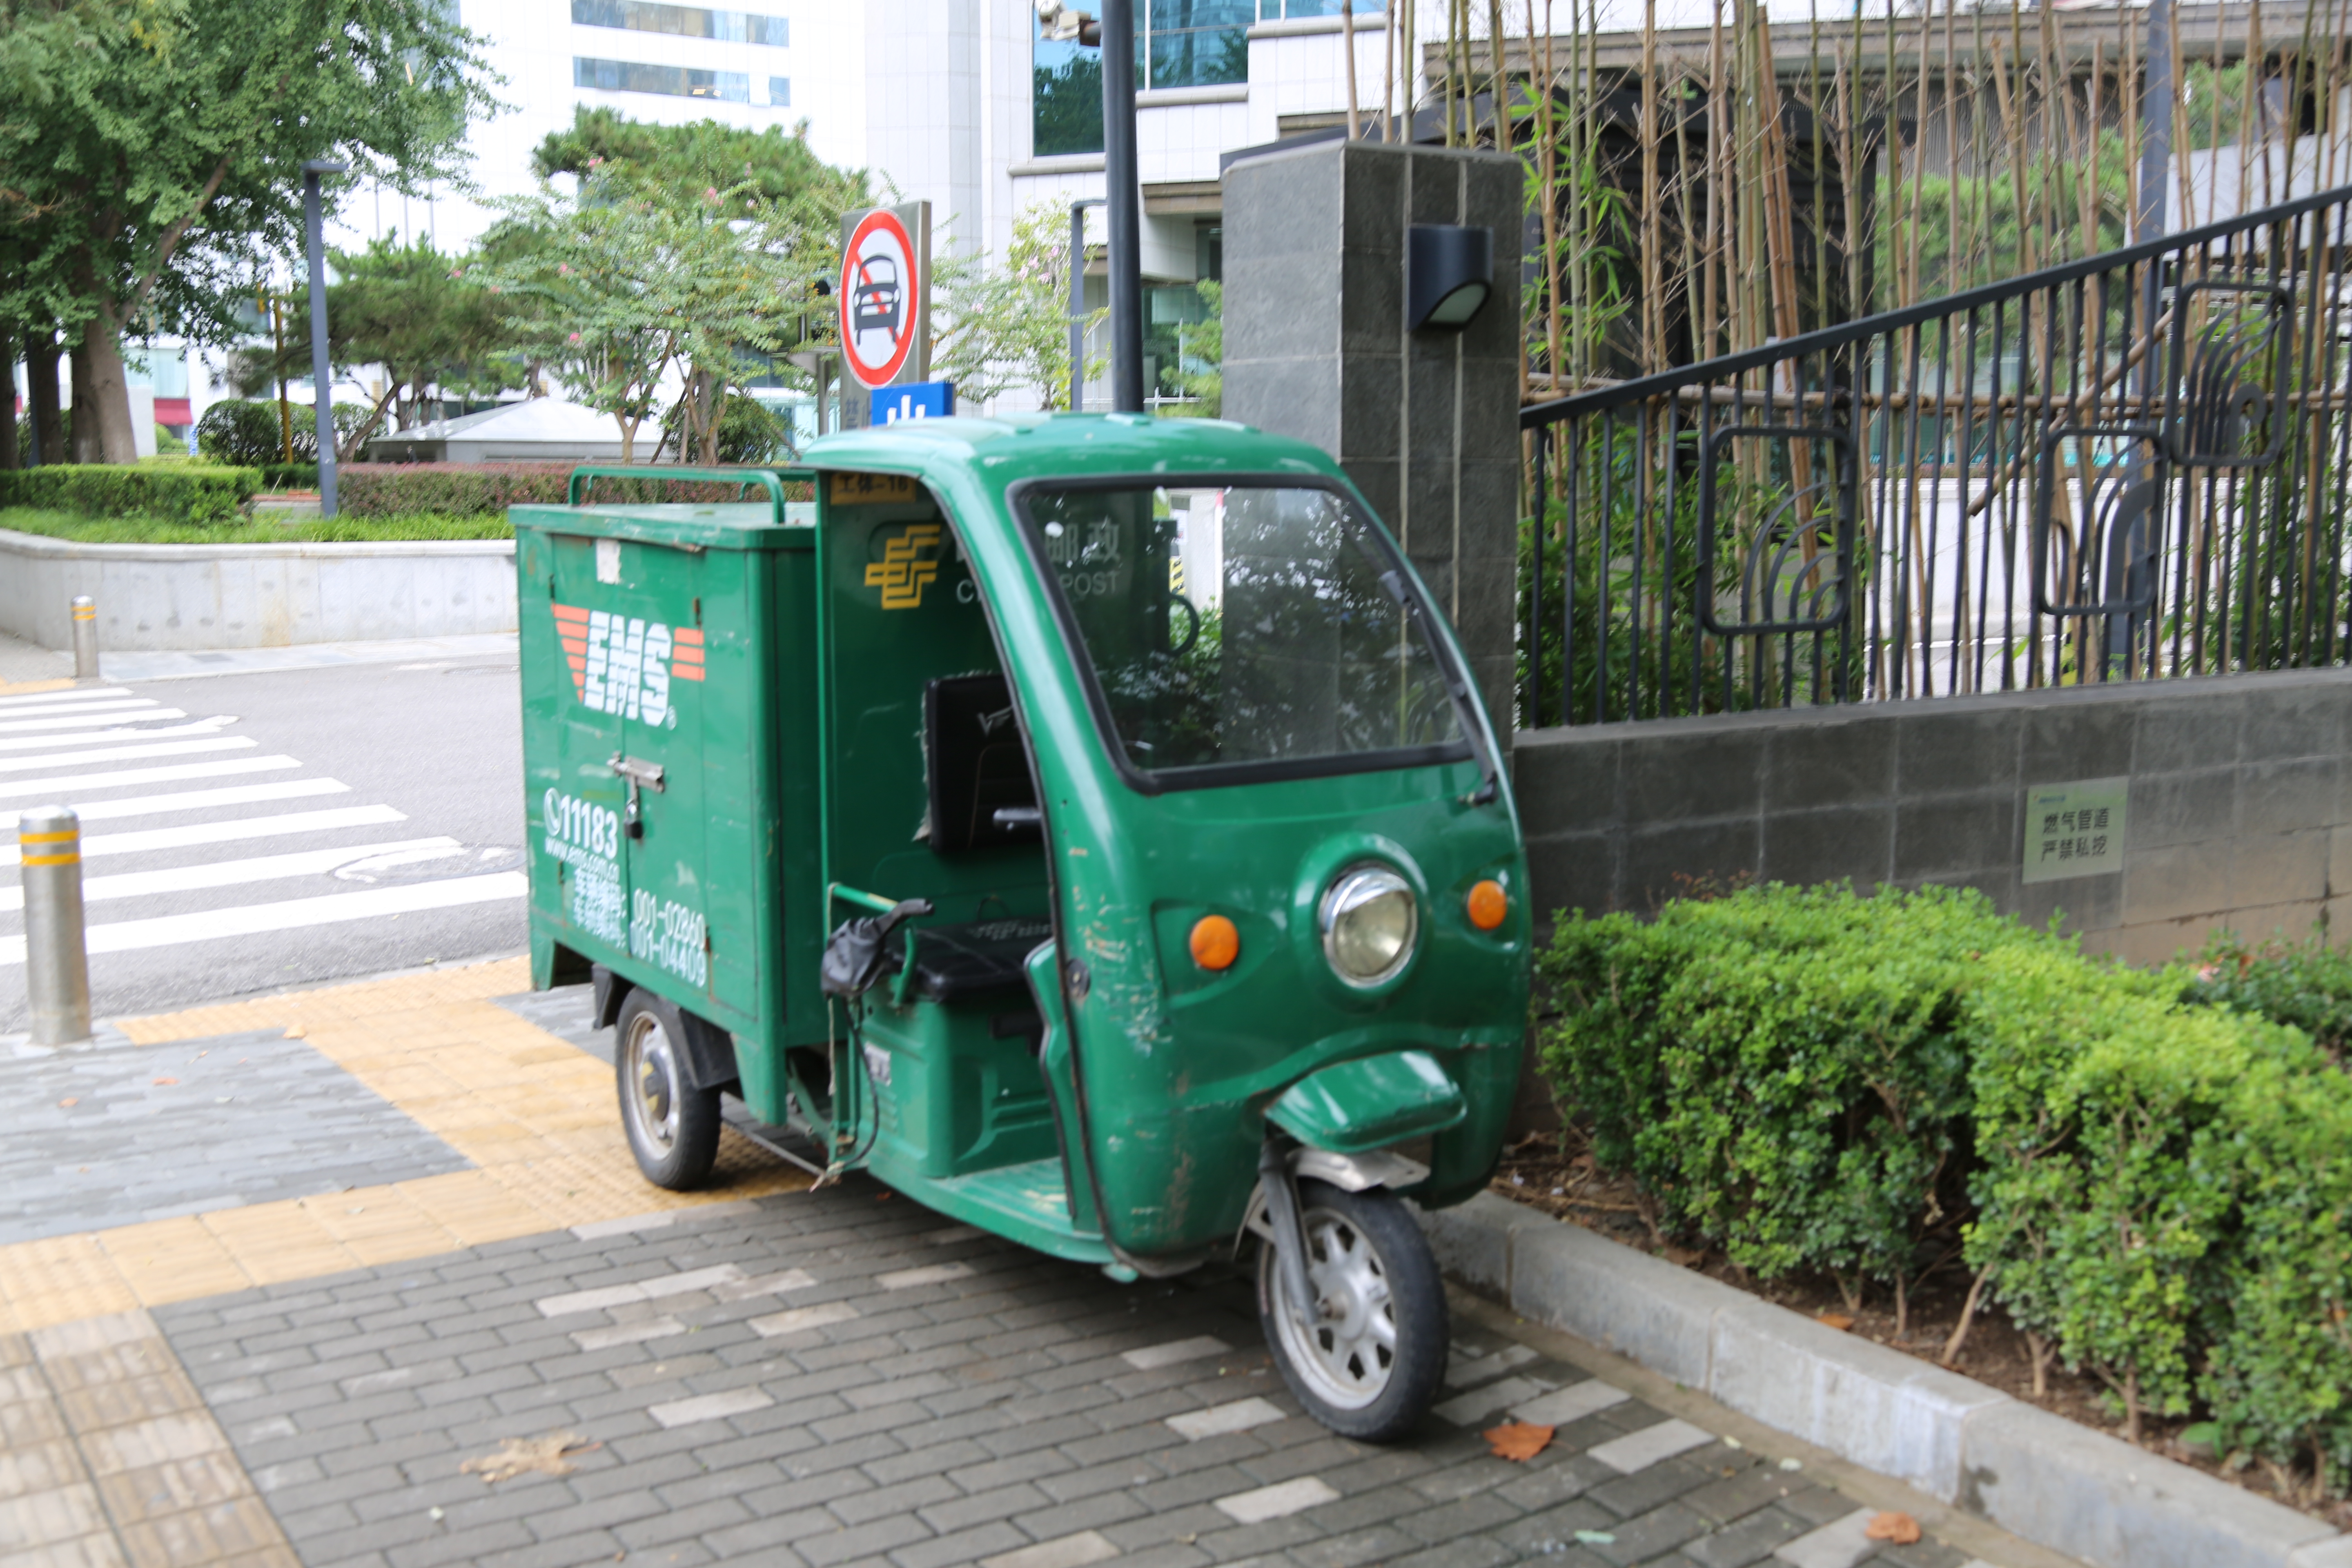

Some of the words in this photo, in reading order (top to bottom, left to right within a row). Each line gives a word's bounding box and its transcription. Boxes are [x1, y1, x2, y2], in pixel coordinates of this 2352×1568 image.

[1062, 571, 1120, 597] POST
[584, 610, 672, 727] EMS
[560, 794, 618, 860] 11183
[2043, 808, 2109, 833] 燃气管道
[2042, 835, 2107, 862] 严禁私挖
